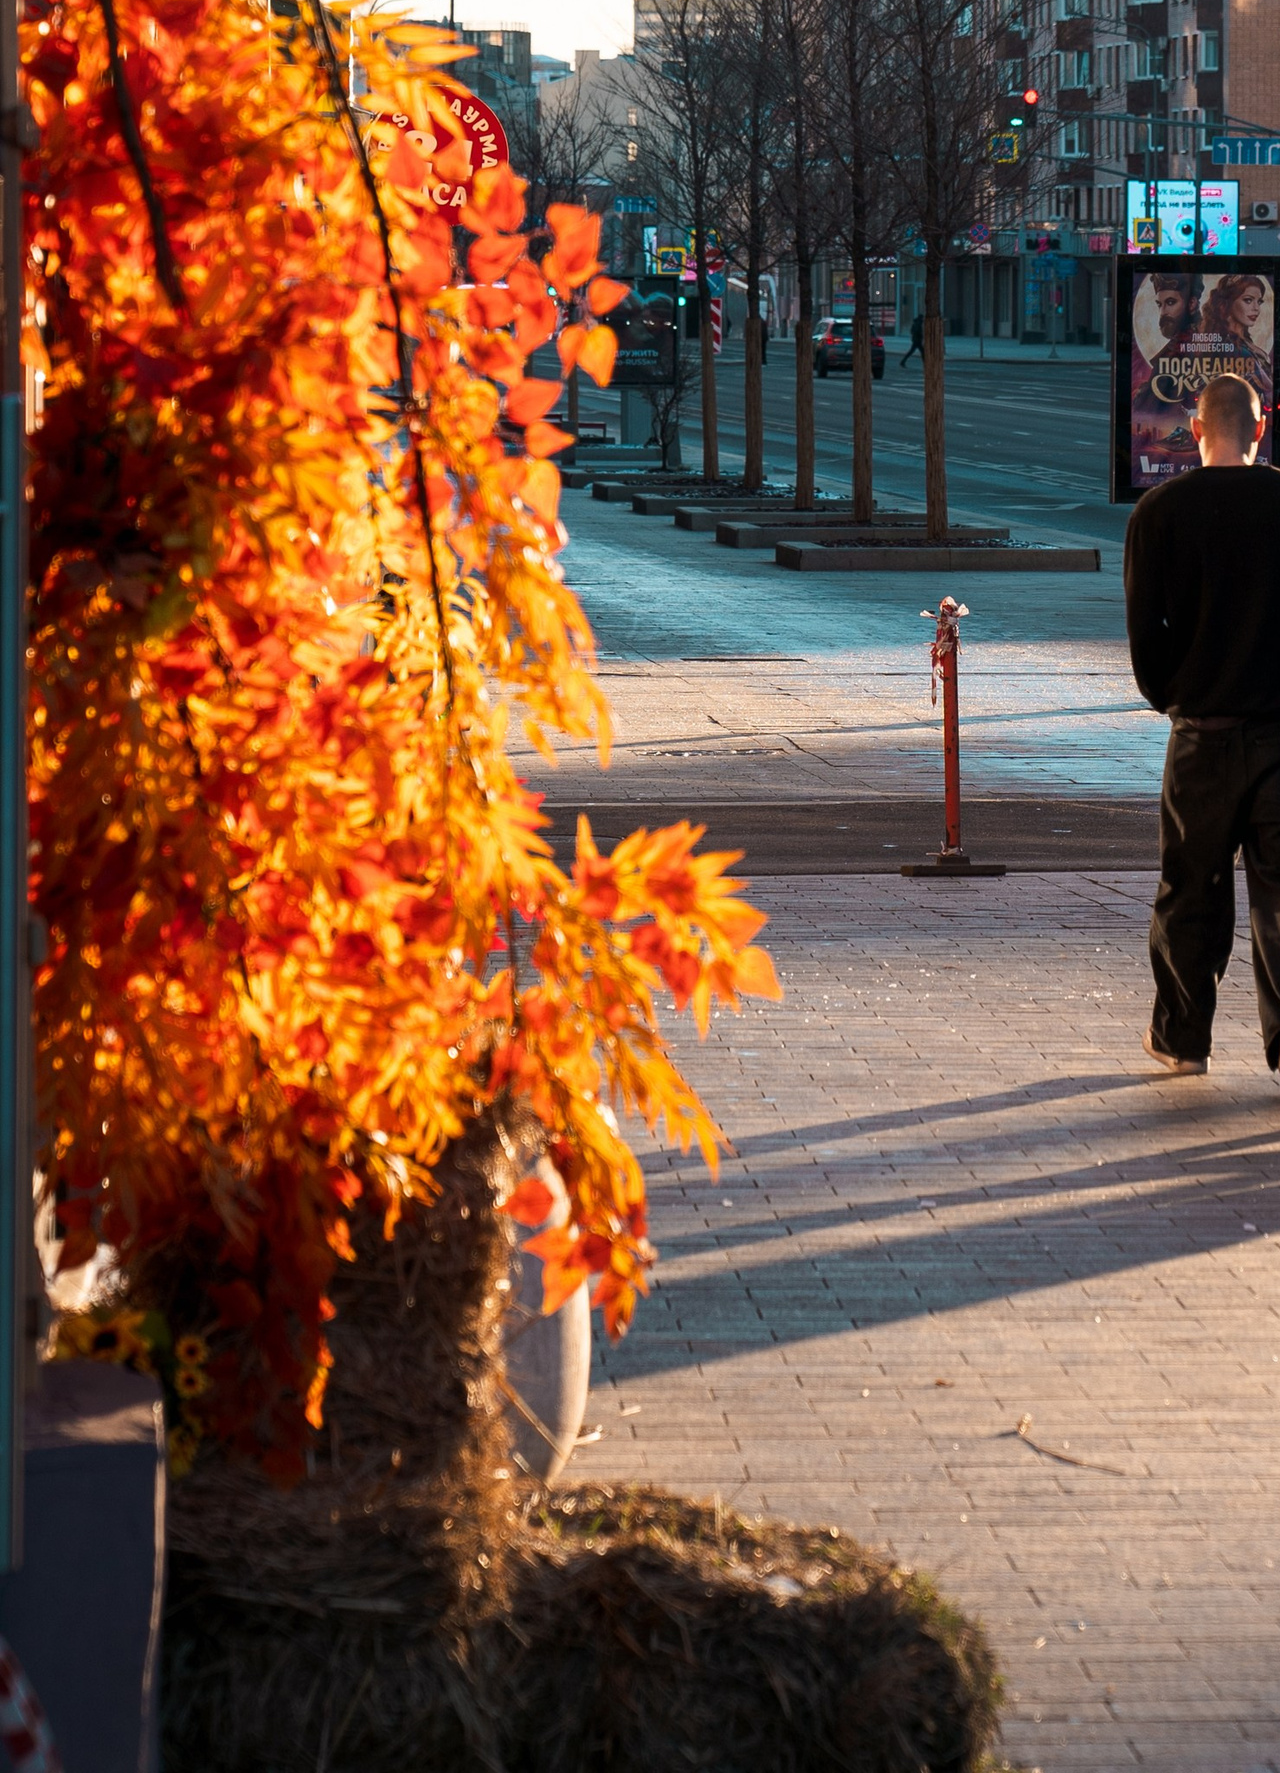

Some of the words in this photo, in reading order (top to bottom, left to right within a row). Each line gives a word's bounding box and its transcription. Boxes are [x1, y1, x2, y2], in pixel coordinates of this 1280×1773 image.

[1169, 188, 1194, 197] Видео
[1192, 333, 1222, 342] ЛЮБОВЬ
[1180, 343, 1185, 352] И
[1187, 343, 1235, 352] ВОЛШЕБСТВО
[1159, 357, 1256, 375] ПОСЛЕДНЯЯ
